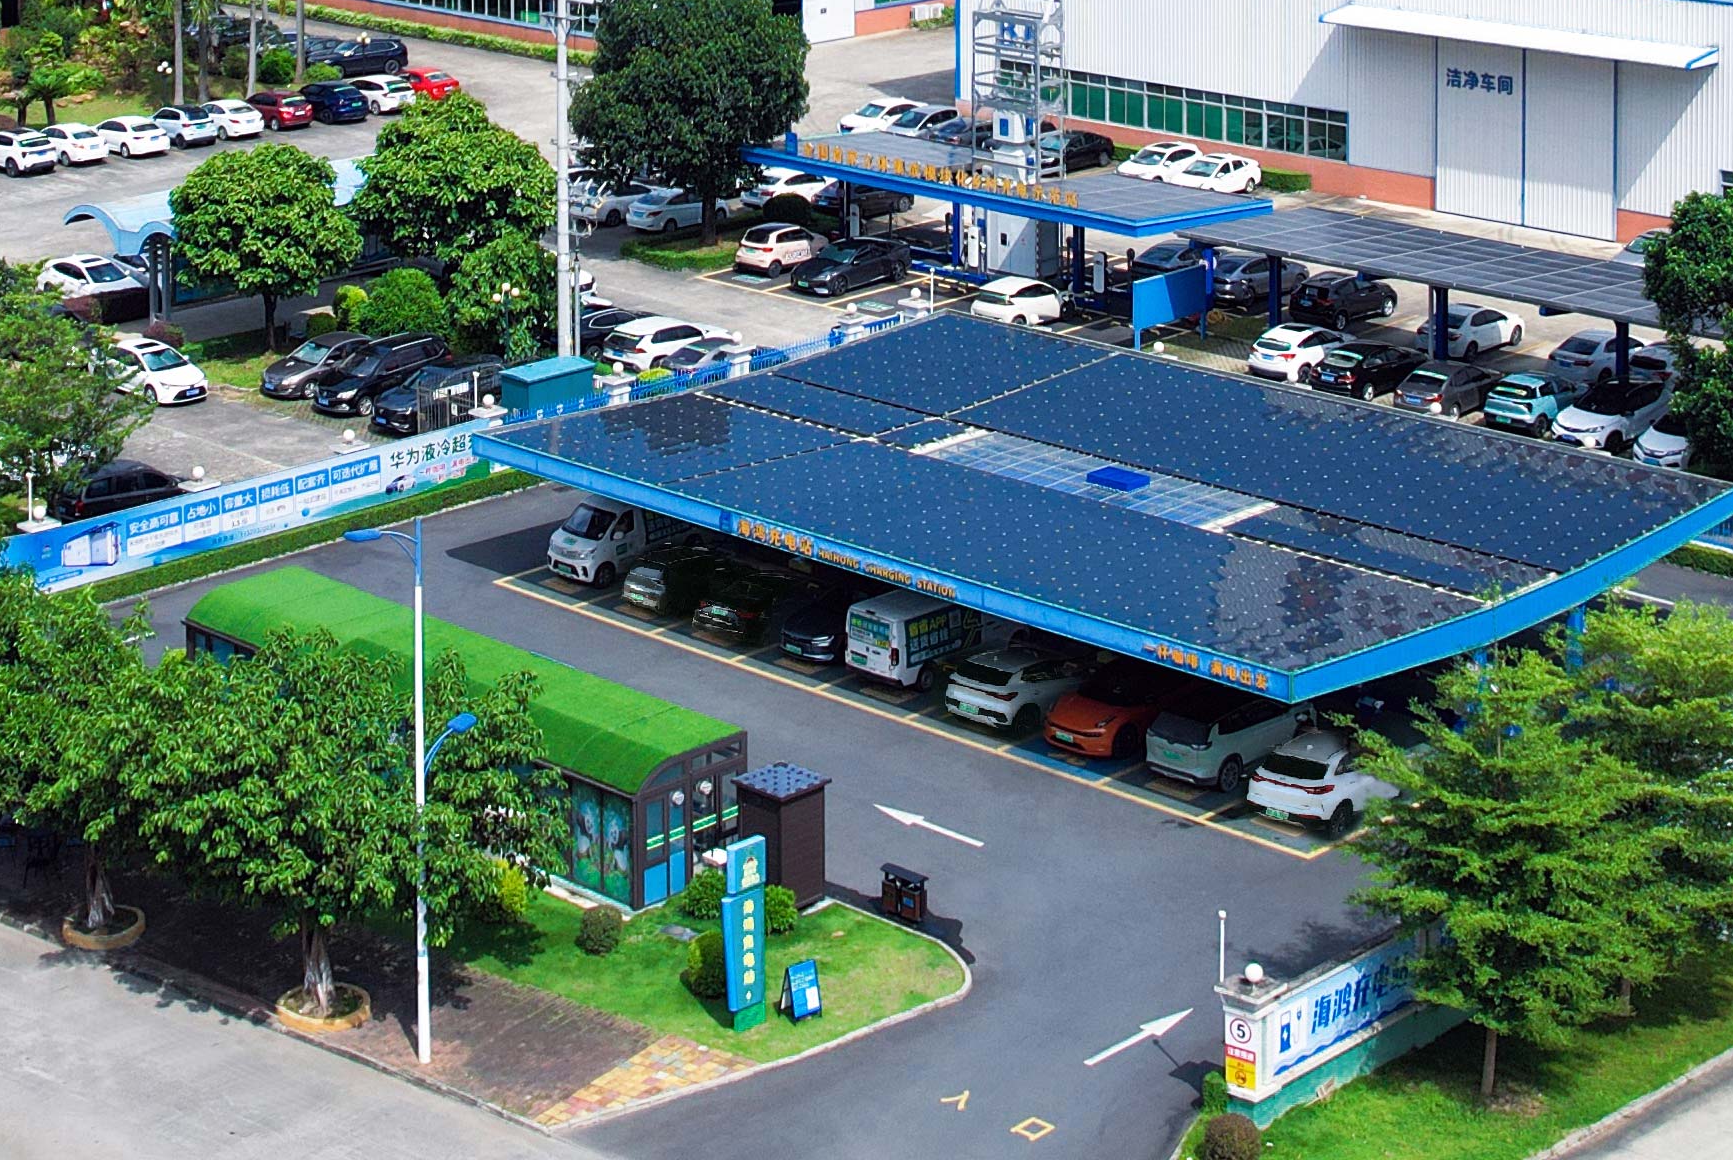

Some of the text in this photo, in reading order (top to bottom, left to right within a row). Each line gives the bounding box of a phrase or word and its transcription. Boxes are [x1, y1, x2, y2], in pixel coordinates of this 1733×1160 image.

[1446, 68, 1513, 95] 洁净车间
[186, 501, 217, 521] 占地小
[223, 492, 253, 511] 容量大
[737, 518, 812, 557] 海鸿充电站
[863, 561, 912, 586] CHARGING
[916, 578, 957, 600] STATION
[1236, 1023, 1246, 1039] 5
